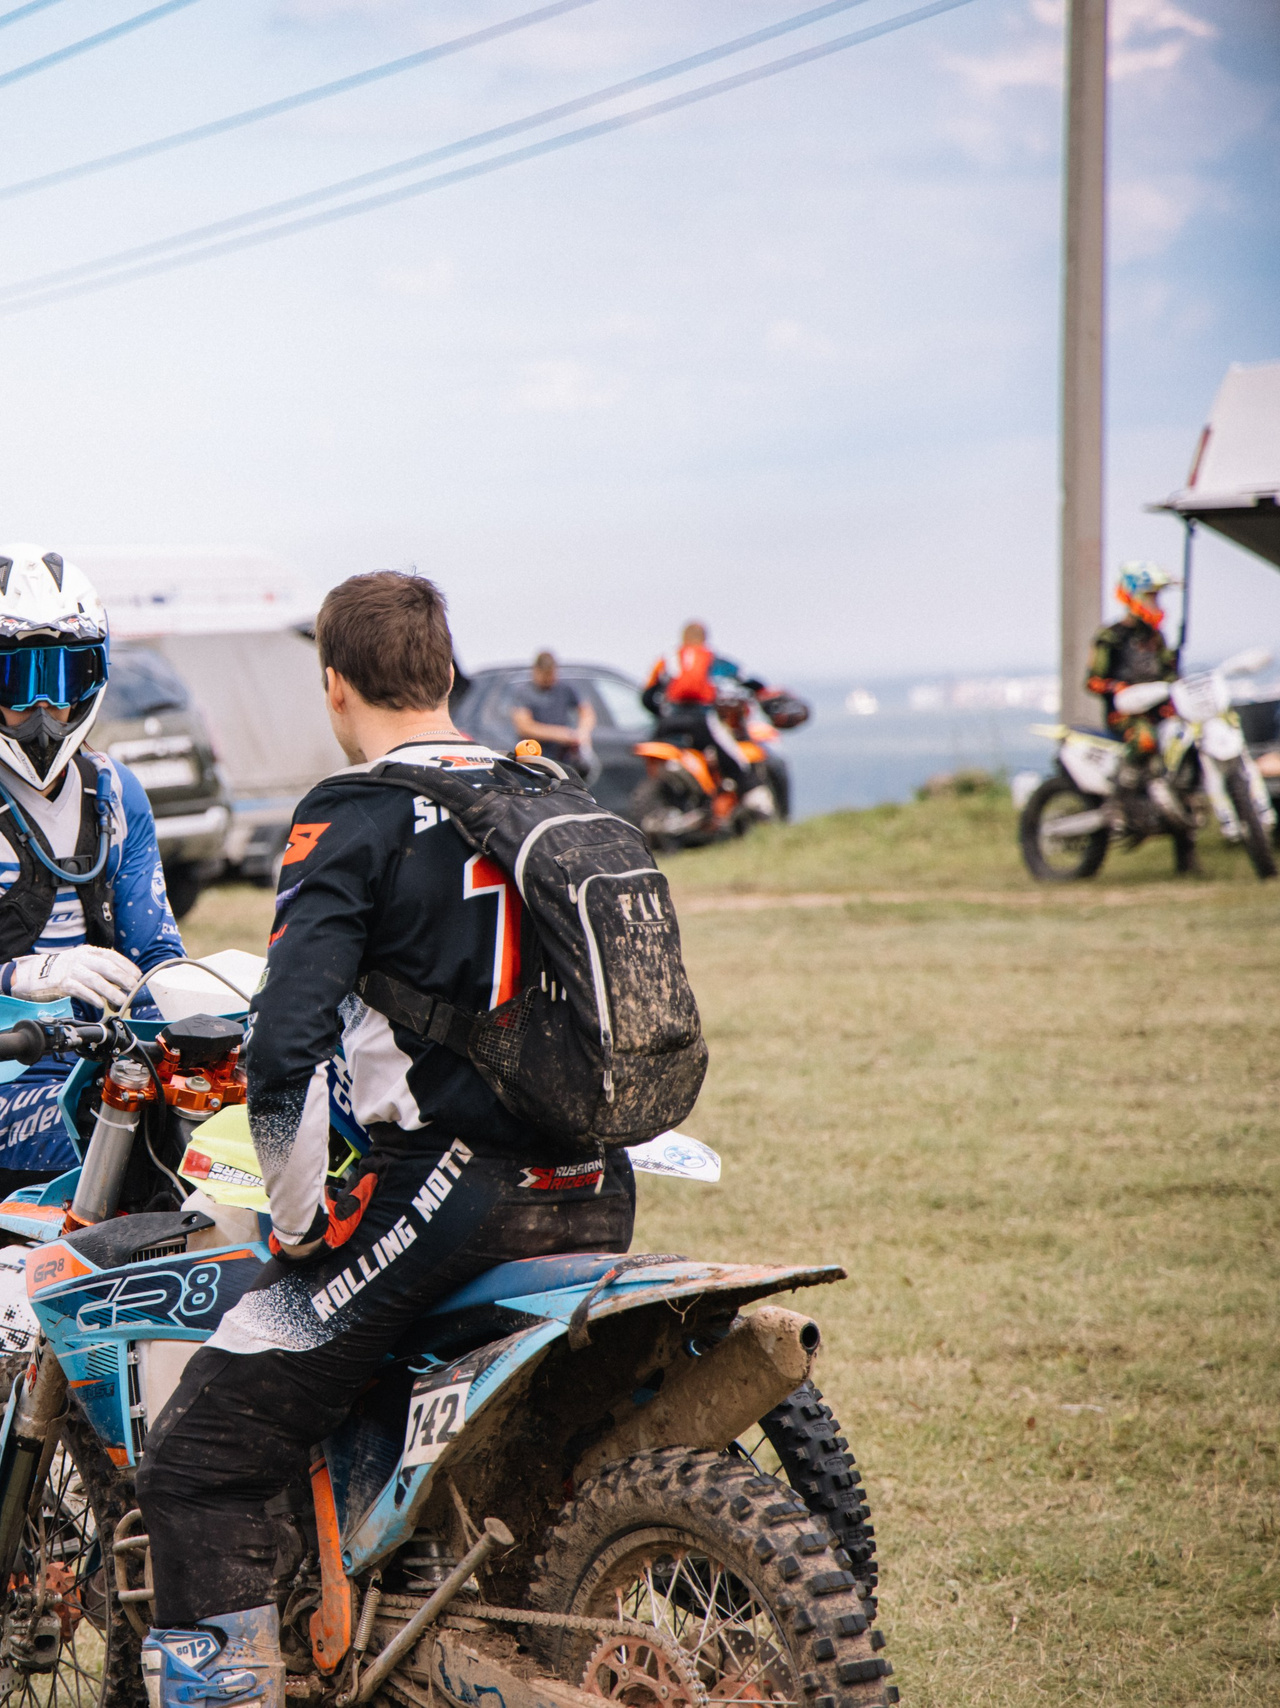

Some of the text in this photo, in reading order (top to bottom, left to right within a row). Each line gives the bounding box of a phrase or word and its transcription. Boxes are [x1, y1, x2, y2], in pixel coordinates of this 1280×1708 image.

[553, 1158, 604, 1177] RUSSIAN
[310, 1214, 418, 1322] ROLLING
[407, 1392, 460, 1454] 142
